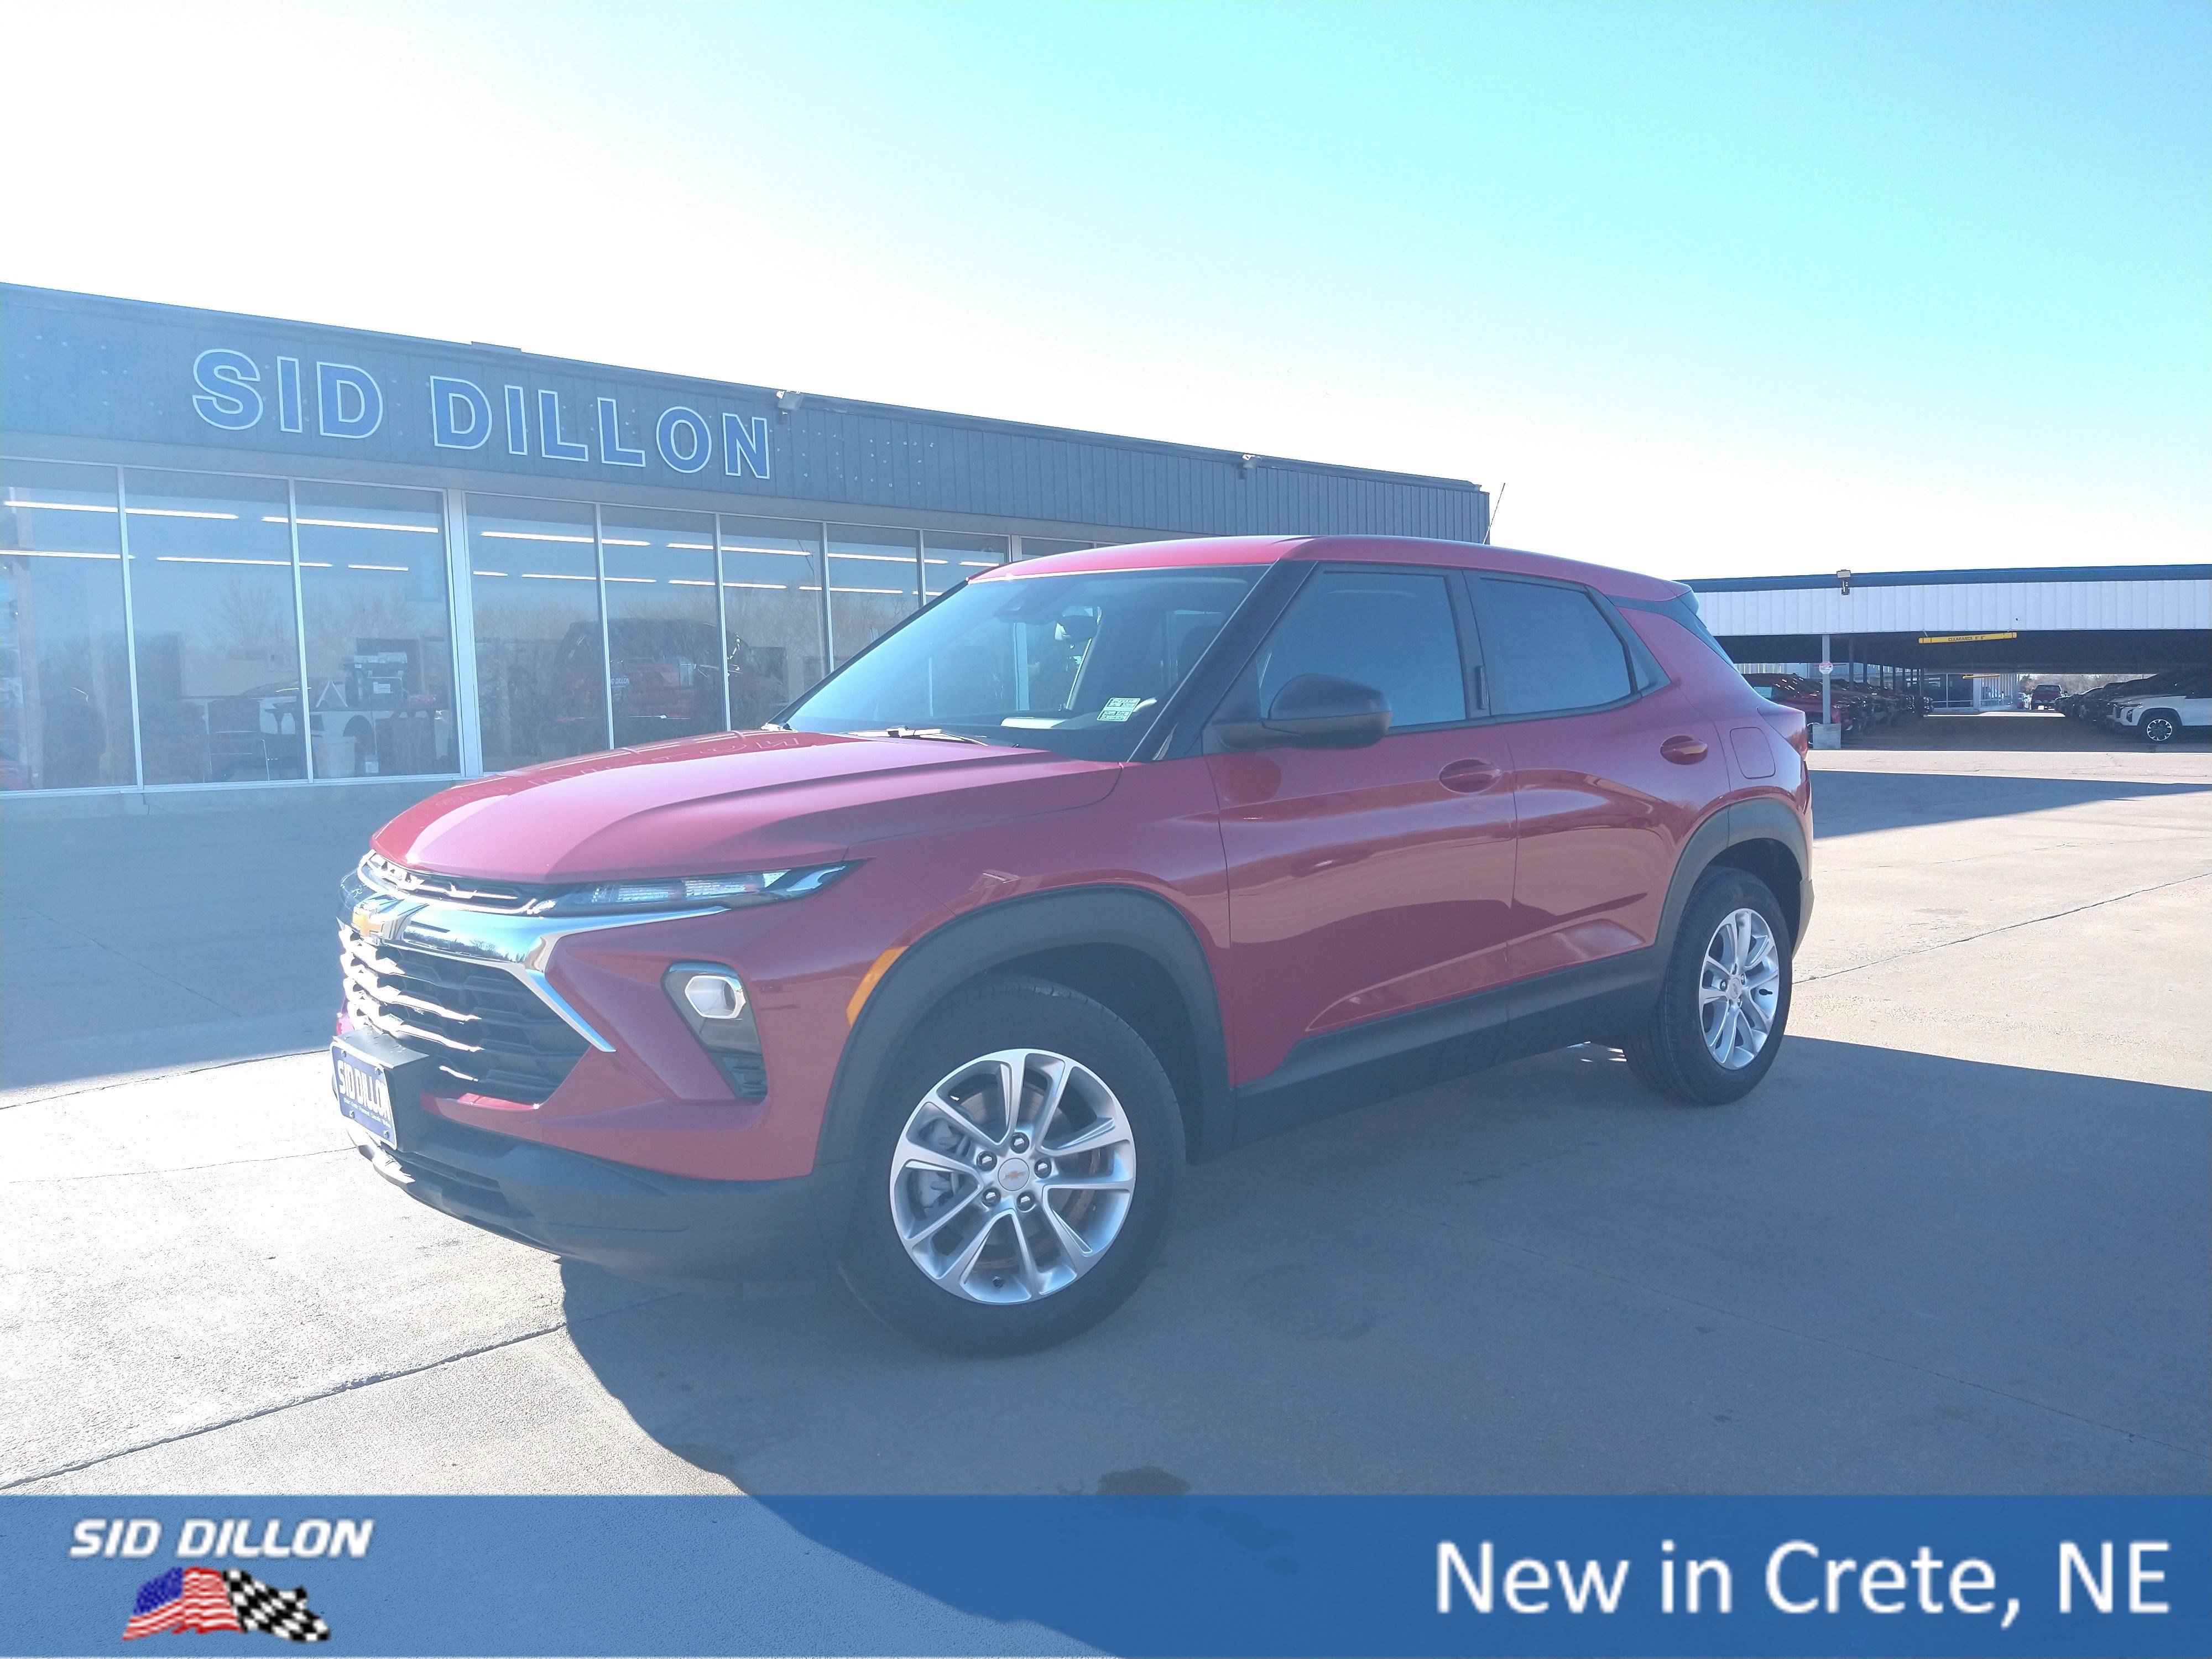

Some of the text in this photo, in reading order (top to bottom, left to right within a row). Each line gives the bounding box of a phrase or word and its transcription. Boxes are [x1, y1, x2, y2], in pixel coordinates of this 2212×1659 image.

[192, 348, 770, 479] SID DILLON
[337, 1060, 356, 1100] SID
